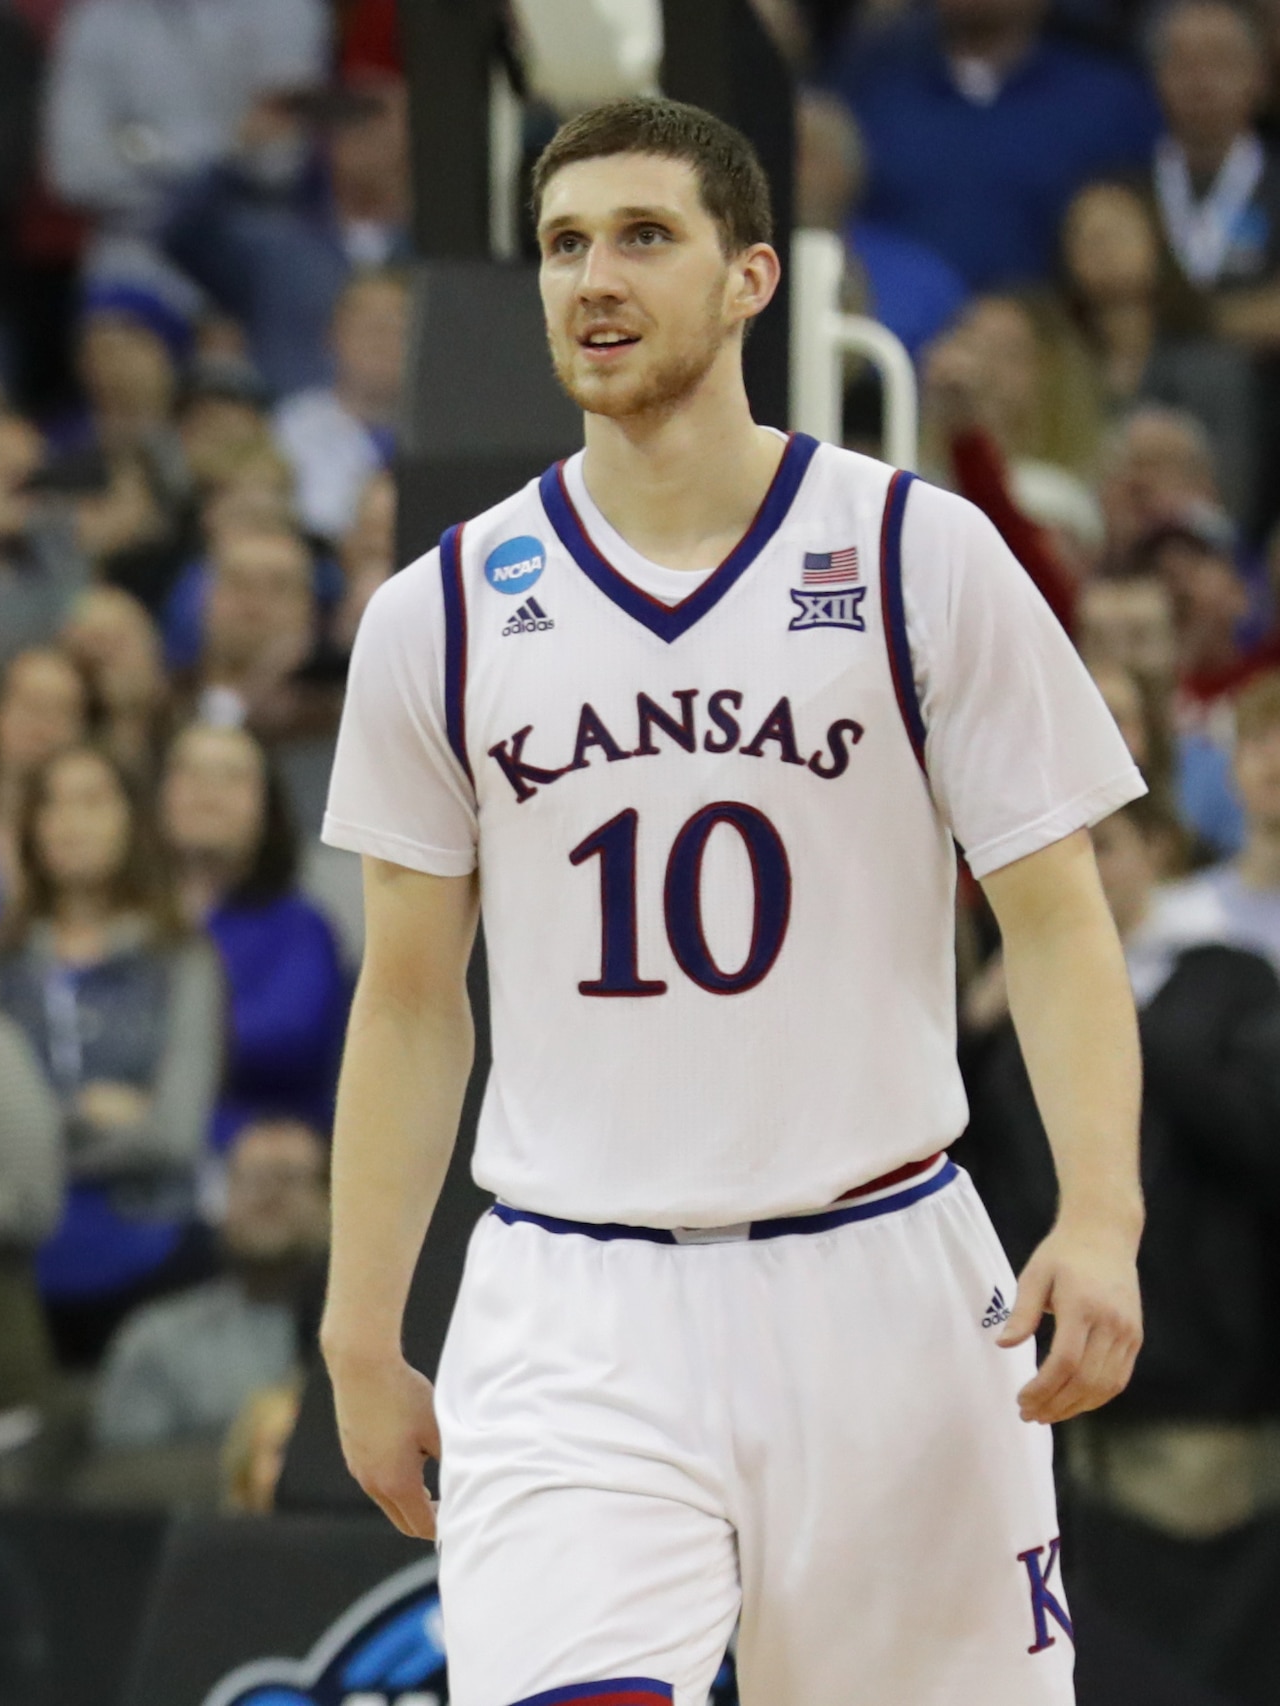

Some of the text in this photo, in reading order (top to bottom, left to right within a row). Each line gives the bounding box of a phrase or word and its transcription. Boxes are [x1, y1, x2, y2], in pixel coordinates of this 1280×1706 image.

[493, 555, 542, 582] NCAA
[501, 618, 555, 637] adidas
[788, 586, 867, 632] XII
[487, 688, 865, 804] KANSAS
[568, 800, 793, 998] 10
